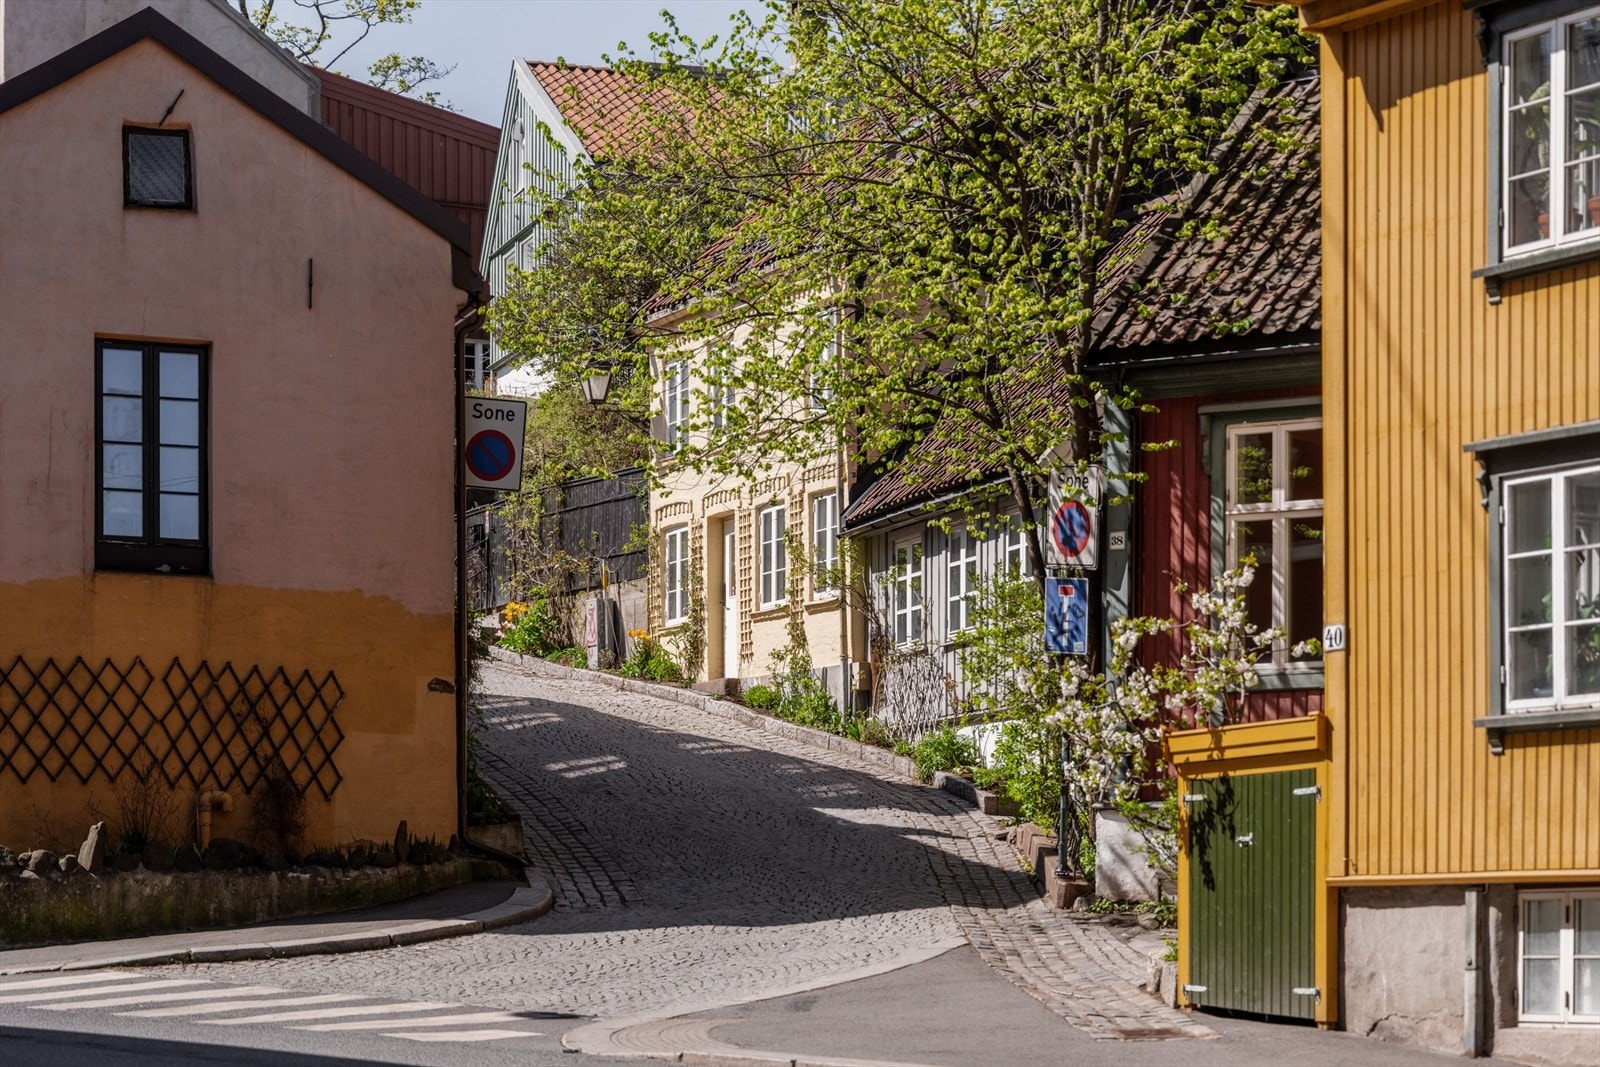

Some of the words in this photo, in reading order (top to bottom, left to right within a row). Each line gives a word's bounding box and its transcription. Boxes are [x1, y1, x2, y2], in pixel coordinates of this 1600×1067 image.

[472, 403, 515, 421] Sone
[1058, 472, 1089, 490] Sone
[1111, 536, 1123, 546] 38
[1325, 627, 1342, 647] 40
